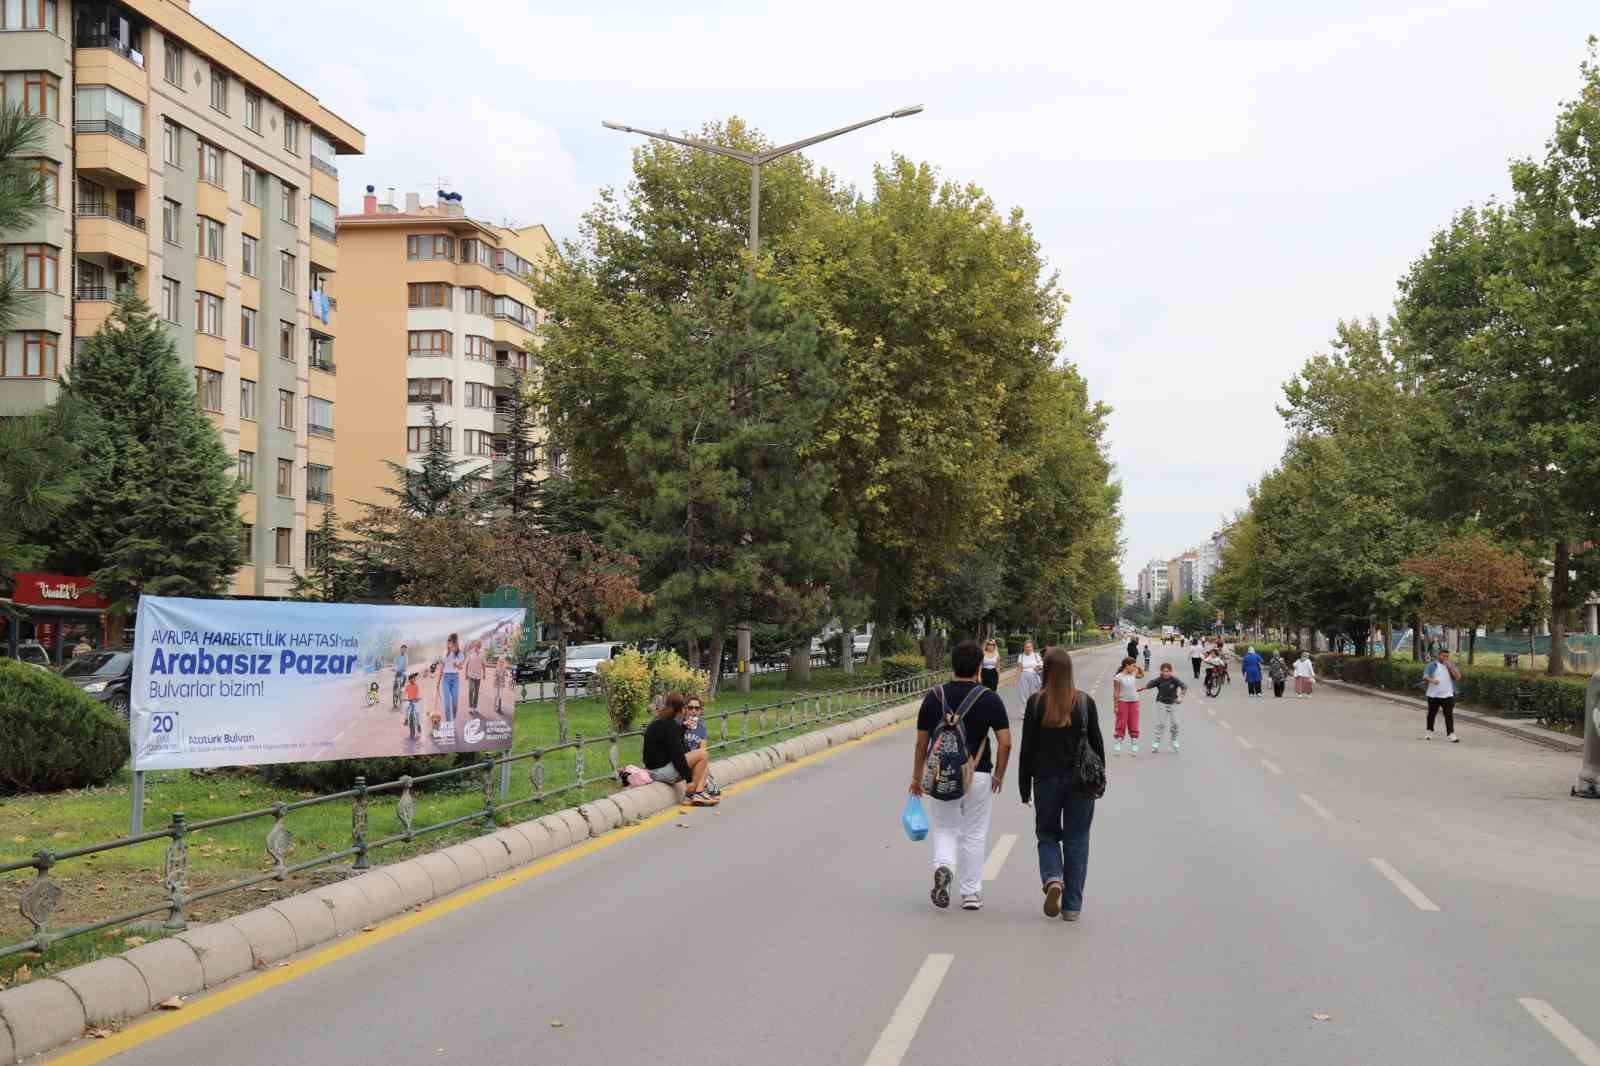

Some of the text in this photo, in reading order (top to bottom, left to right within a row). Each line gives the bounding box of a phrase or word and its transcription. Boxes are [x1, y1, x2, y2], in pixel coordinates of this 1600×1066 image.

[151, 630, 199, 645] AVRUPA
[202, 629, 287, 647] HAREKETLİLİK
[150, 647, 358, 675] Arabasız Pazar
[149, 679, 265, 698] Bulvarlar bizim!
[152, 715, 174, 733] 20
